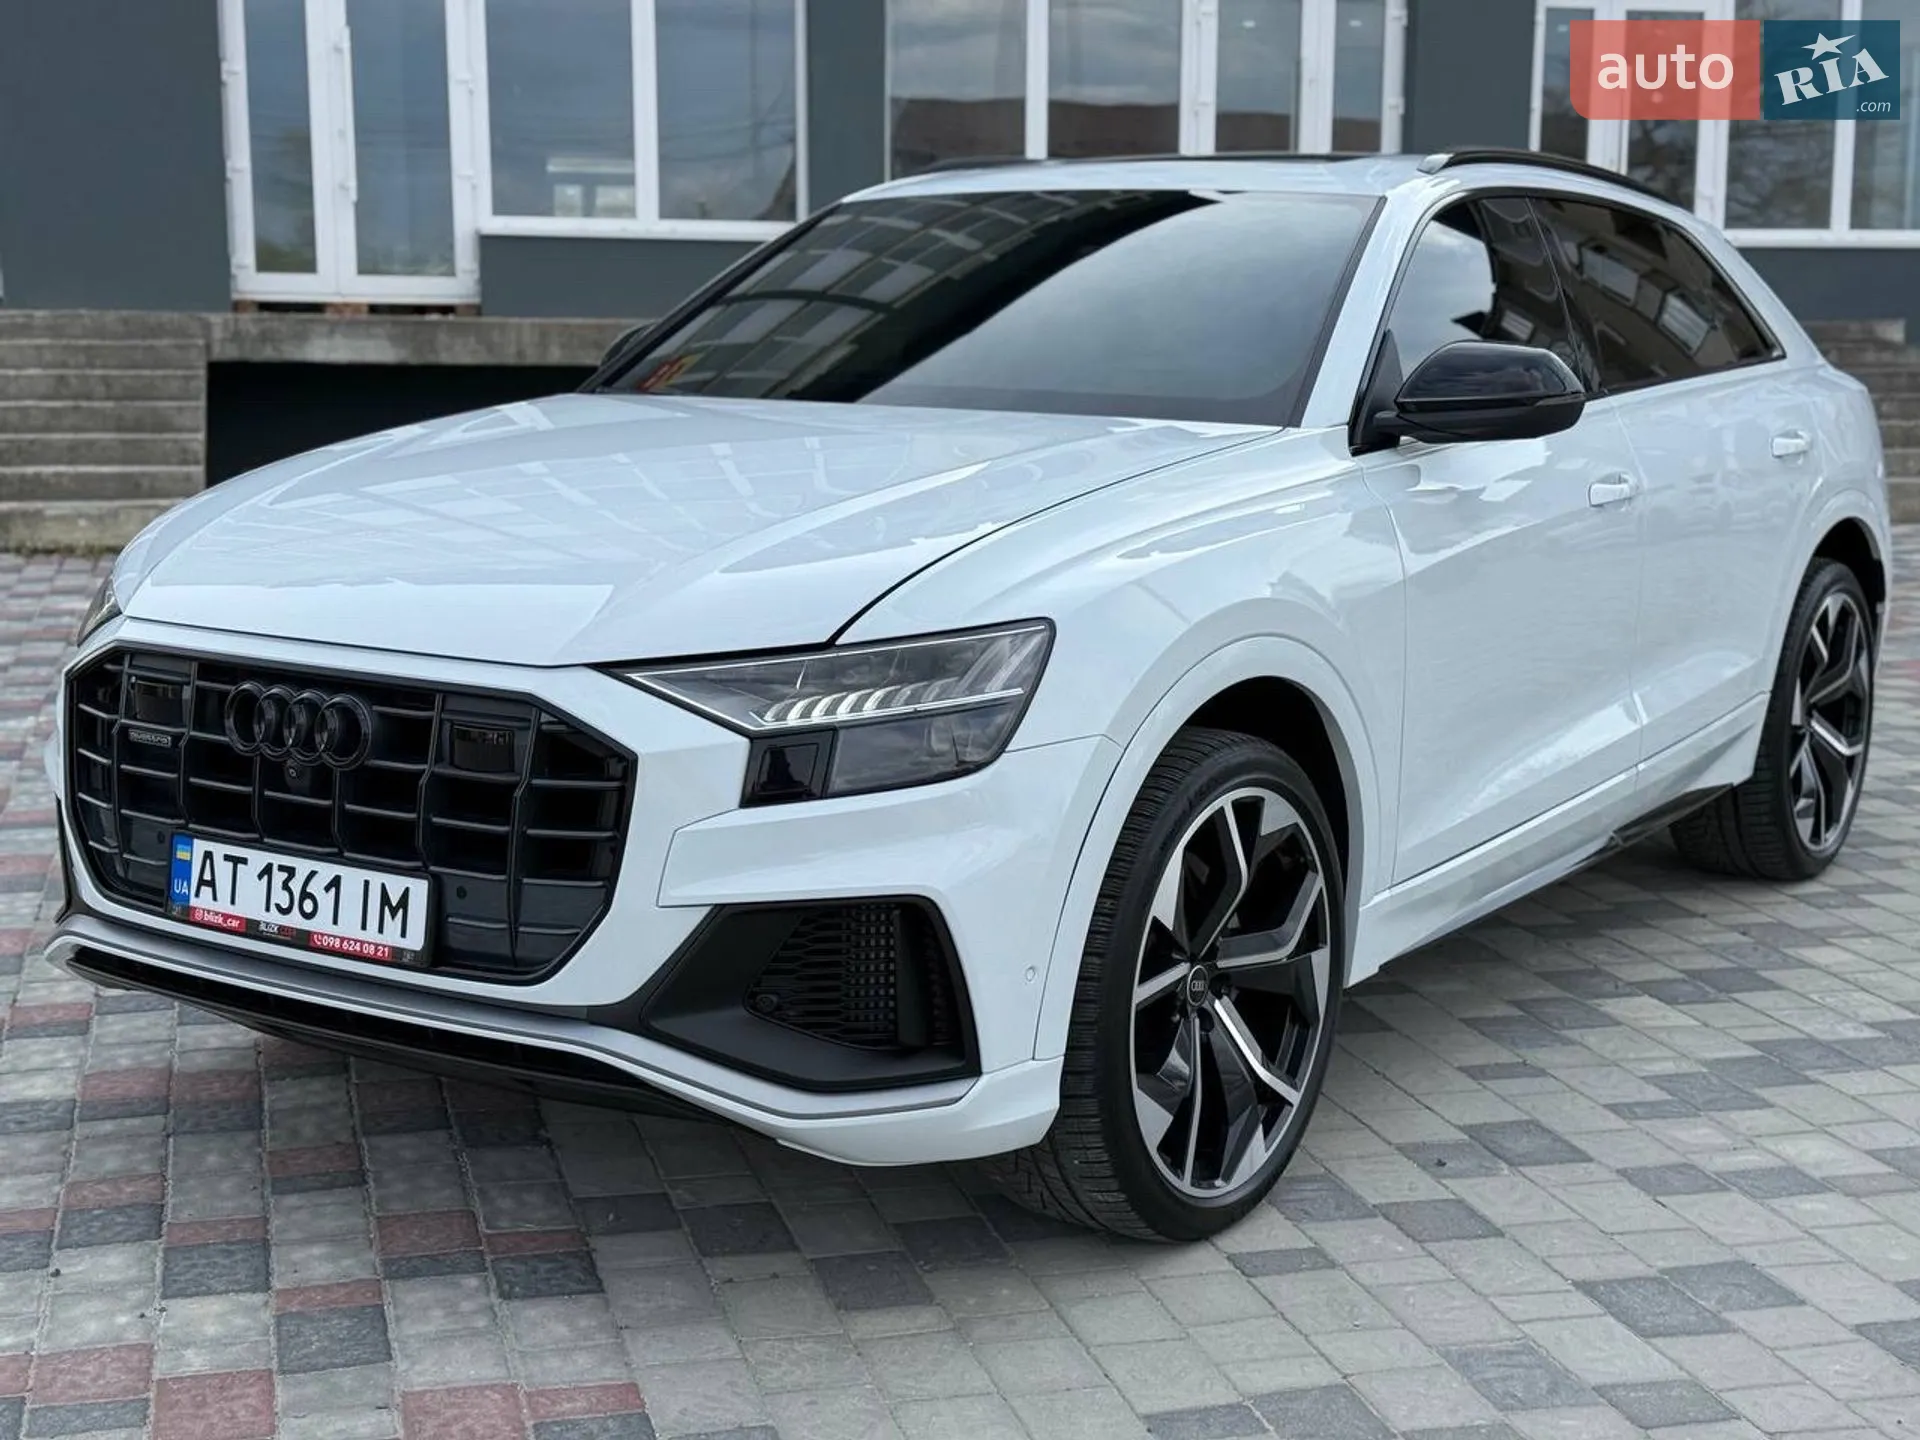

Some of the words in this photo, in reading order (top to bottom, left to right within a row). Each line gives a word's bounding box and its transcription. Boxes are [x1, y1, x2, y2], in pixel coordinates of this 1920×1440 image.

[174, 879, 189, 895] UA
[194, 850, 249, 906] AT
[257, 862, 342, 926] 1361
[361, 879, 411, 939] IM
[322, 936, 341, 948] 098
[342, 940, 360, 951] 624
[377, 946, 389, 957] 21
